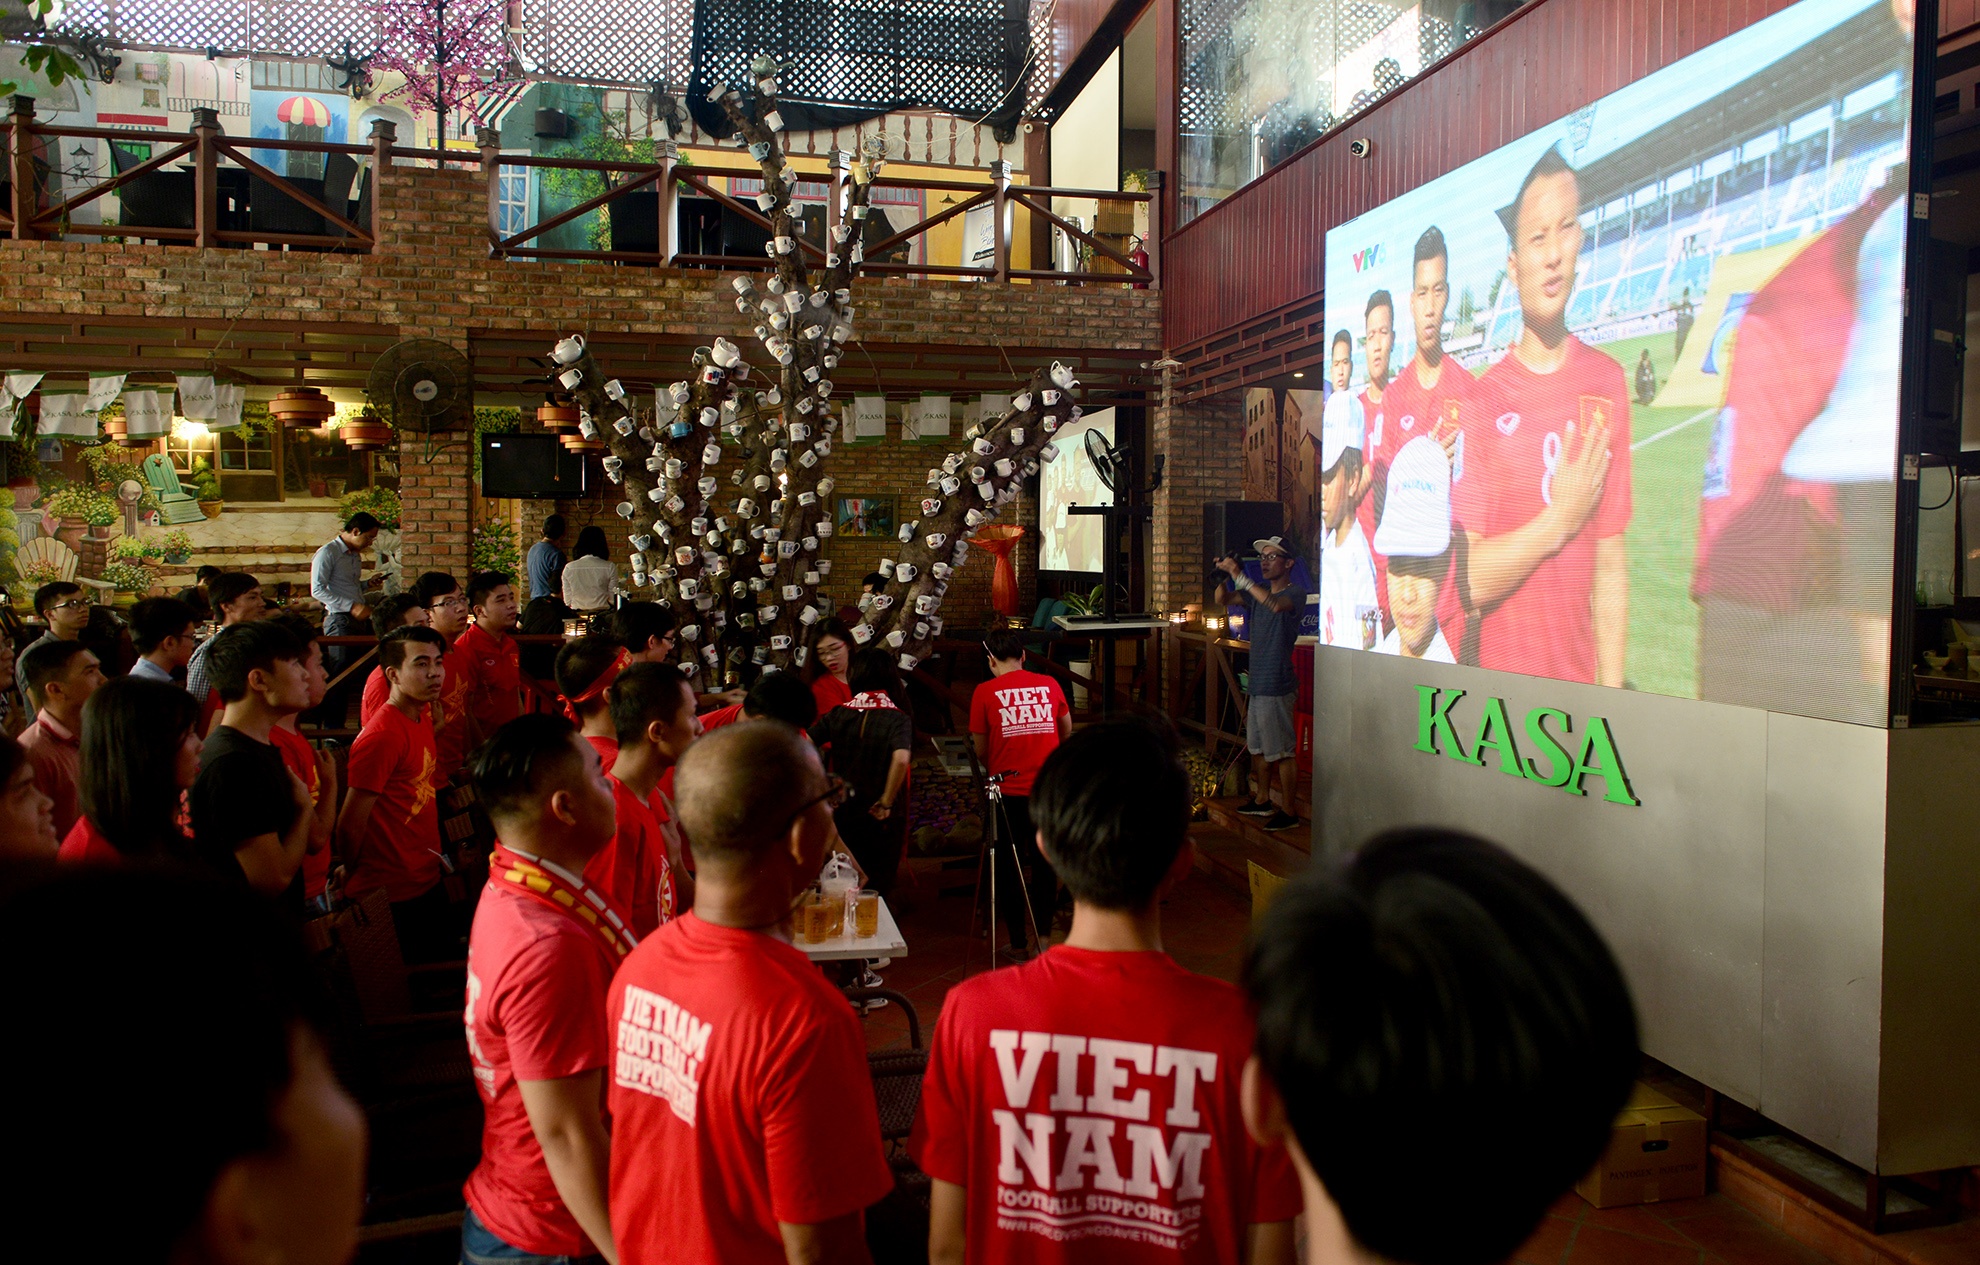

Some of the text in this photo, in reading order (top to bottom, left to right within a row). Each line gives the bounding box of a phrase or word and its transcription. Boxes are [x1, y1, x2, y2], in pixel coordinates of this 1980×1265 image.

[994, 686, 1050, 707] VIET
[998, 703, 1054, 726] NAM
[1413, 684, 1640, 806] KASA
[617, 1019, 699, 1093] FOOTBALL
[622, 984, 713, 1062] VIETNAM
[989, 1029, 1218, 1128] VIET
[992, 1108, 1212, 1201] NAM
[1659, 1162, 1699, 1175] INJECTION
[997, 1184, 1202, 1227] FOOTBALL SUPPORTERS
